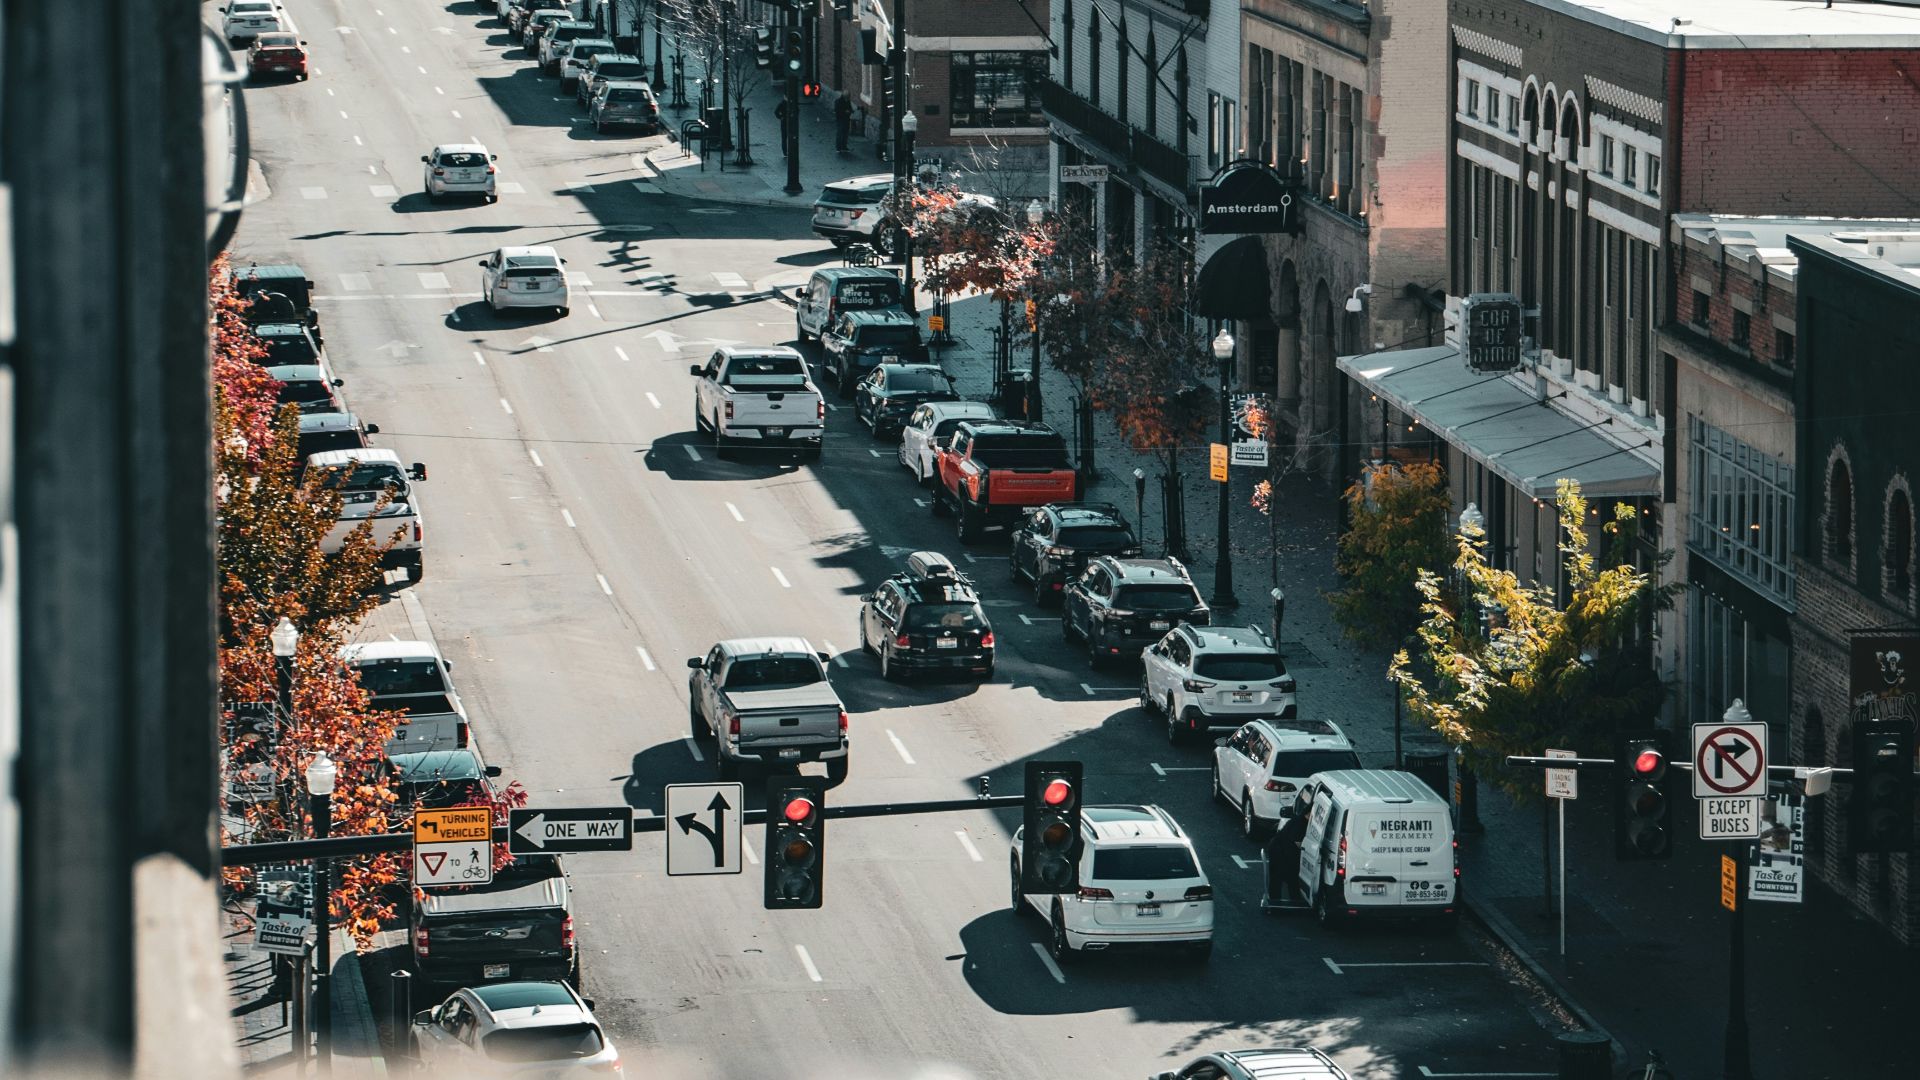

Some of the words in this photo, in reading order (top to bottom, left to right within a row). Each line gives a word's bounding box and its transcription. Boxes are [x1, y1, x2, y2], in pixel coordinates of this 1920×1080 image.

[1207, 203, 1279, 214] Amsterdam
[840, 296, 874, 306] Bulldog
[1481, 309, 1510, 327] COA
[1486, 327, 1506, 345] DE
[1708, 799, 1752, 815] EXCEPT
[441, 814, 485, 824] TURNING
[1711, 817, 1750, 833] BUSES
[545, 823, 576, 838] ONE
[587, 822, 619, 837] WAY
[1380, 820, 1432, 831] NEGRANTI
[440, 827, 486, 839] VEHICLES
[1381, 832, 1434, 840] CREAMERY
[1371, 846, 1391, 854] SHEEP'S
[1392, 846, 1404, 854] MILK
[450, 858, 461, 867] TO
[1755, 870, 1784, 881] Taste
[1785, 872, 1798, 883] of
[1756, 882, 1795, 892] DOWNTOWN
[261, 921, 290, 934] Taste
[292, 925, 306, 936] of
[262, 934, 301, 946] DOWNTOWN
